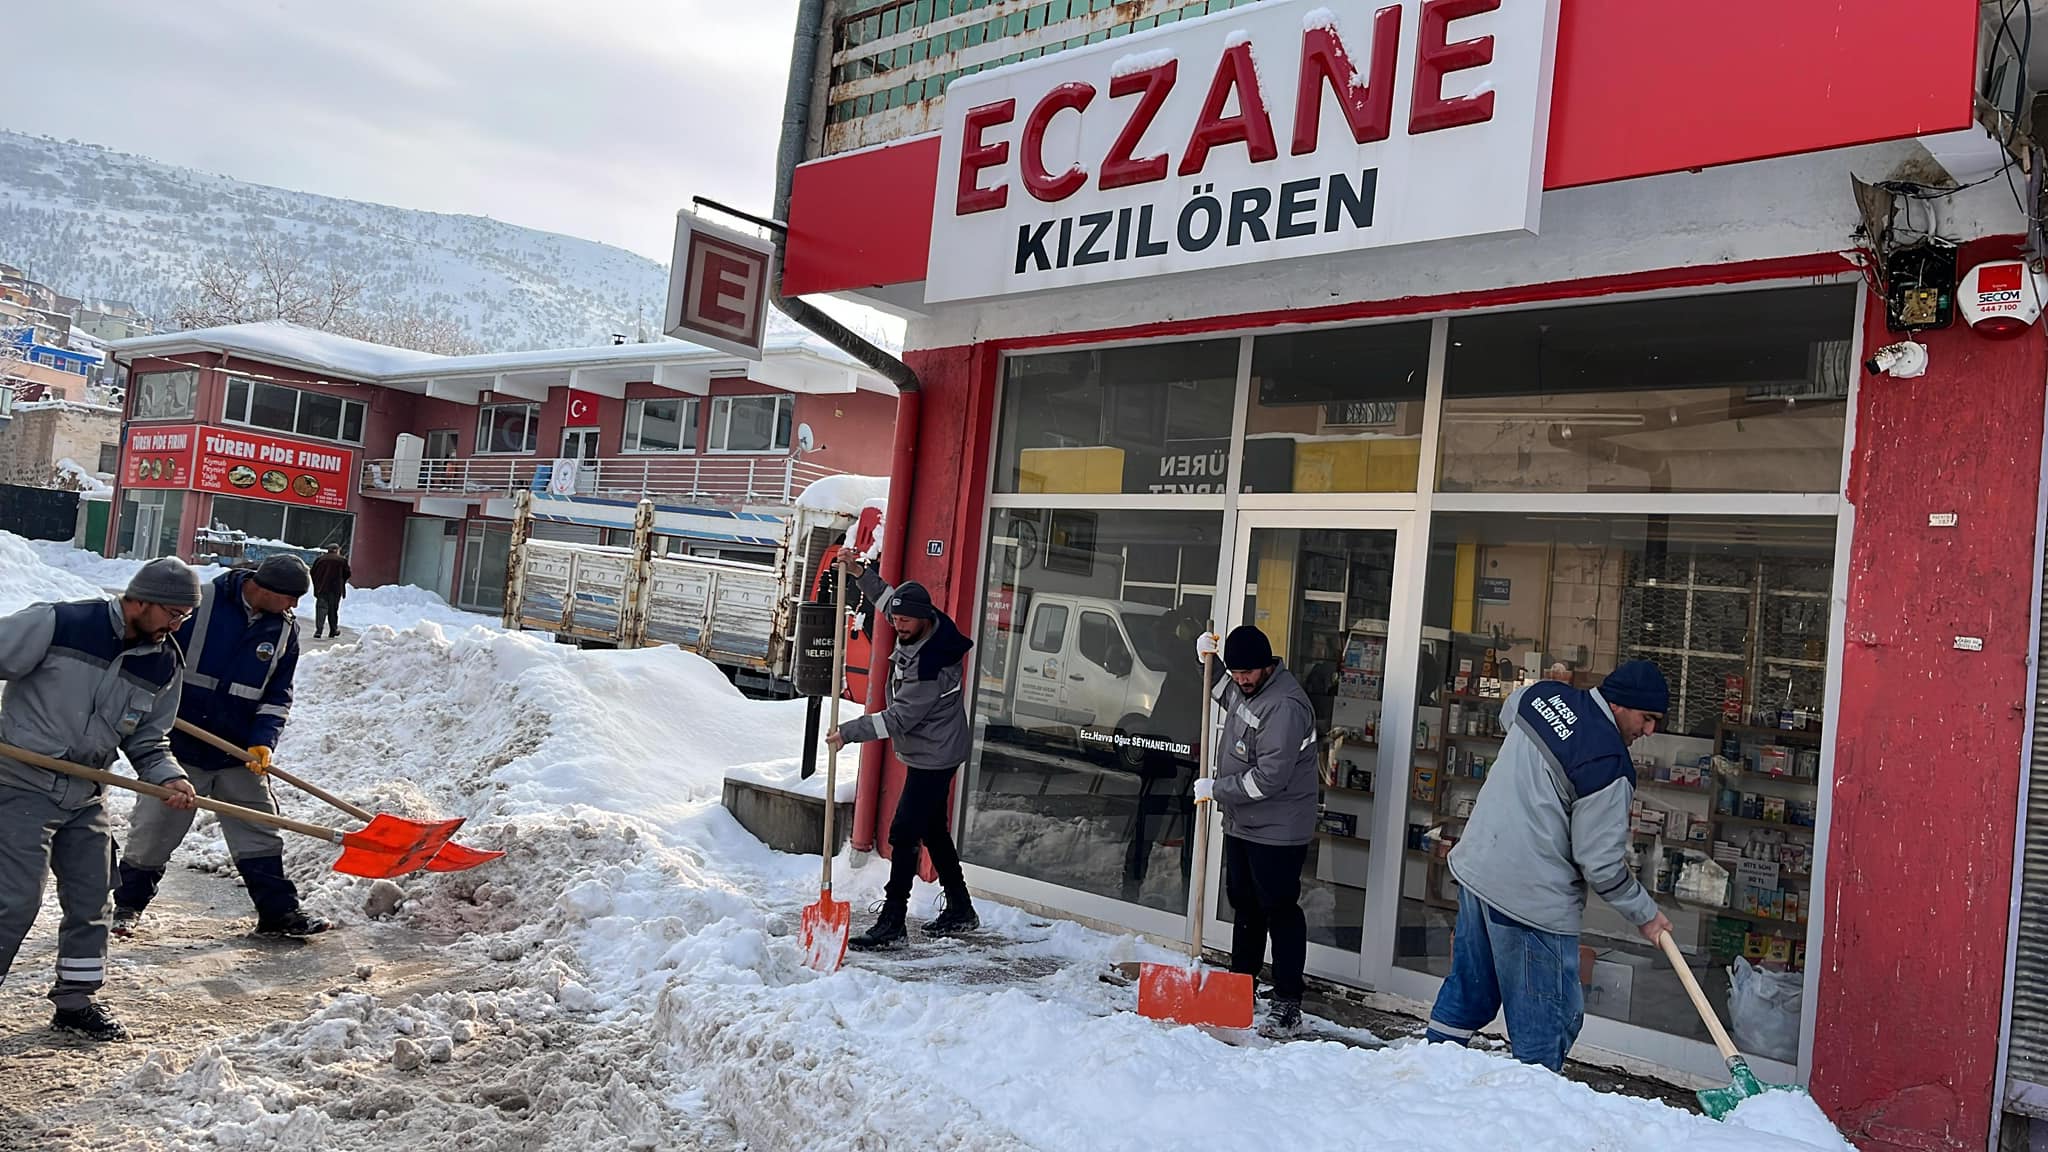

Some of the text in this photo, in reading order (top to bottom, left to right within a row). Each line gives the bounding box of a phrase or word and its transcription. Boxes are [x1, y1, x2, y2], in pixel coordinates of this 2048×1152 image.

[955, 0, 1501, 216] ECZANE
[1014, 167, 1379, 275] KIZILÖREN
[698, 250, 750, 330] E
[1979, 291, 2020, 303] SECOM
[132, 431, 188, 450] TÜREN PİDE FIRINI
[205, 434, 342, 472] TÜREN PİDE FIRINI
[1531, 696, 1574, 741] BELEDİYESİ
[1548, 694, 1578, 725] İNCESU
[1080, 729, 1191, 755] Ecz.Havva Oğuz SEYHANEYILDIZI
